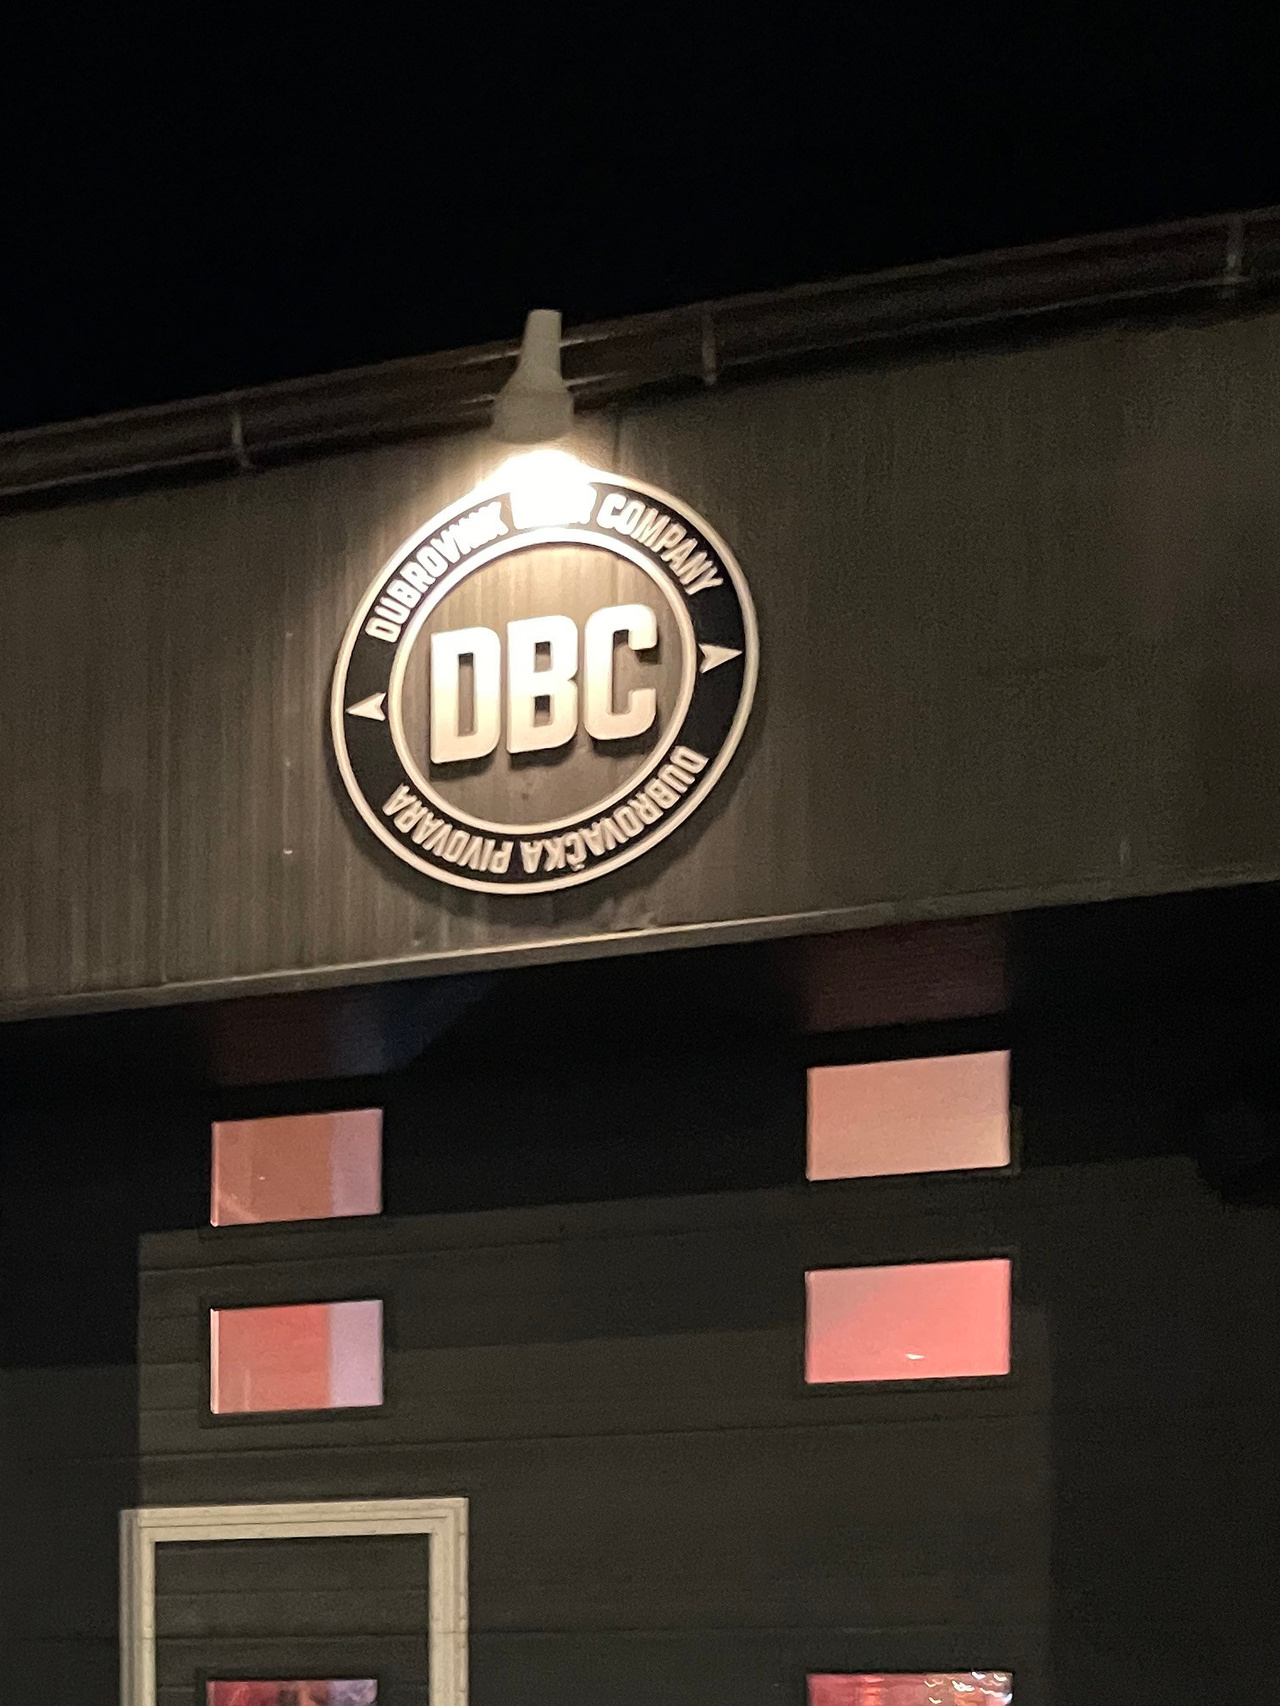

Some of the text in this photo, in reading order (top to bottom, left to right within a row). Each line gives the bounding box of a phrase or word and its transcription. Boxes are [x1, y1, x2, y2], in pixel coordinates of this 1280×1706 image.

[596, 492, 724, 595] COMPANY
[429, 604, 658, 764] DBC
[381, 745, 709, 874] DUBROVAČKA PIVOVARA
